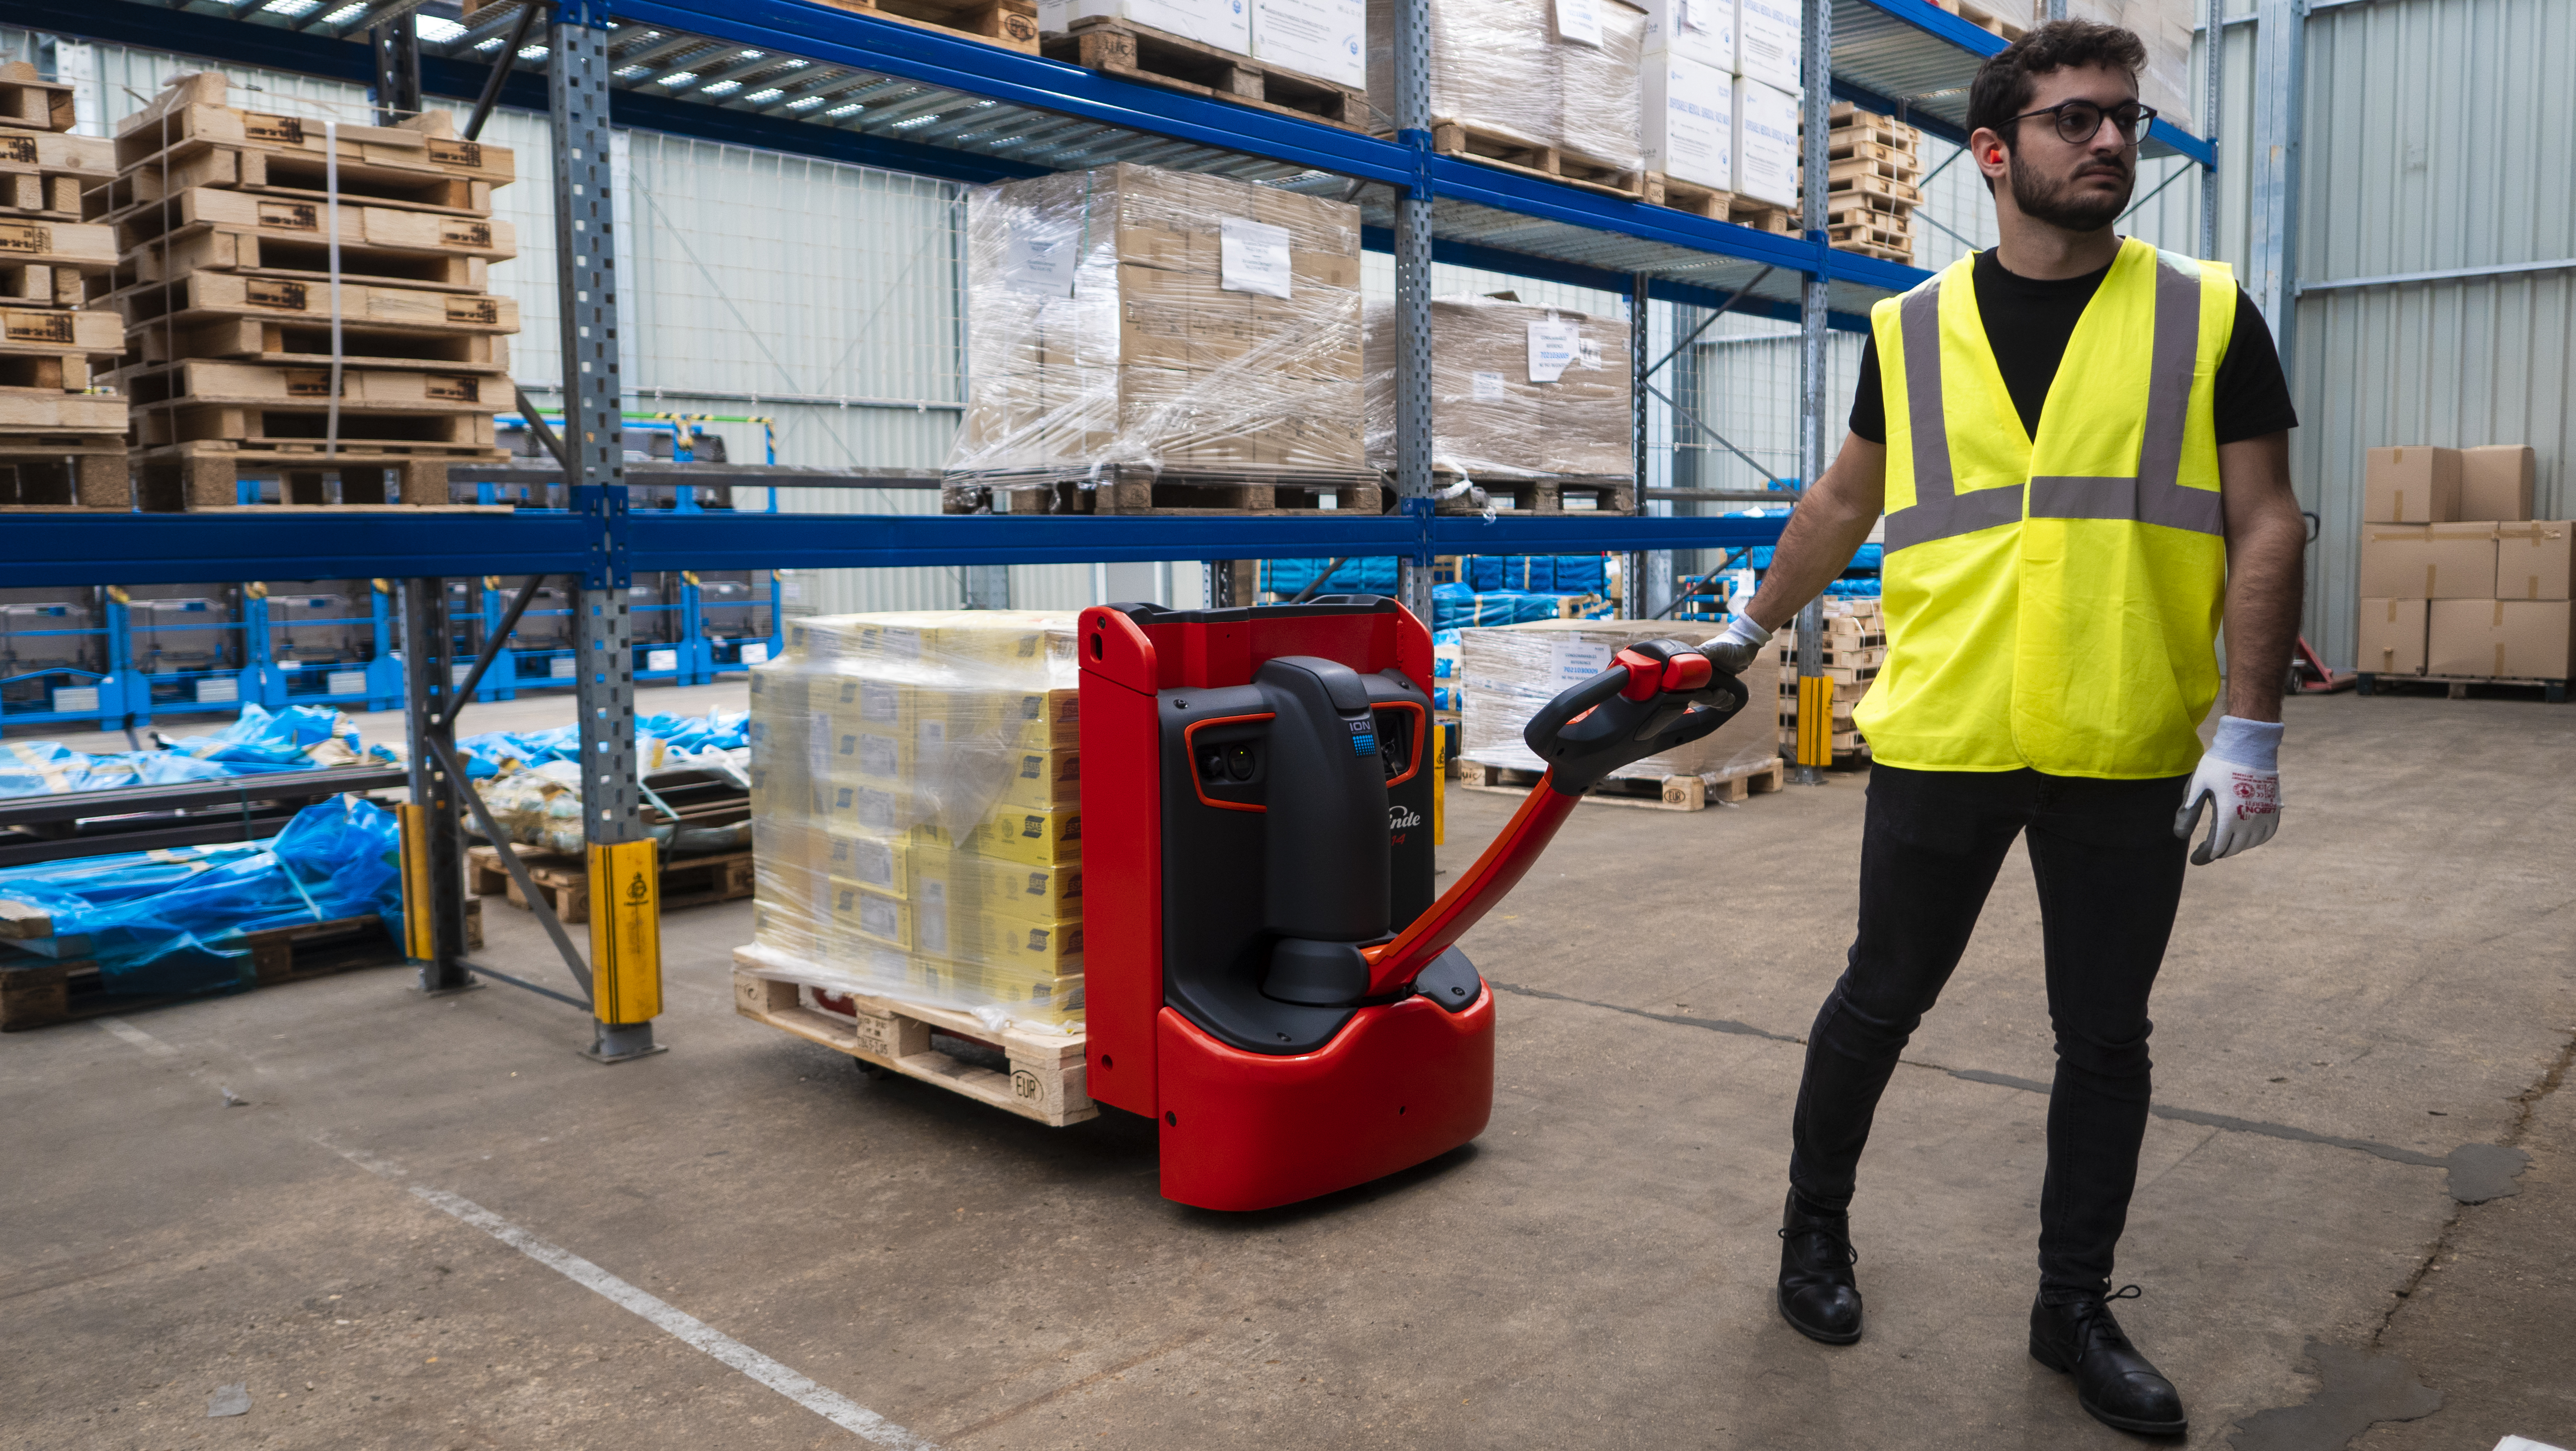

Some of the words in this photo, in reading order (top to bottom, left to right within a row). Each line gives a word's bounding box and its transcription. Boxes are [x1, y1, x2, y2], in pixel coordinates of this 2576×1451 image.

[1563, 666, 1599, 674] 7021030009
[1349, 721, 1370, 731] ION
[1669, 791, 1681, 802] EUR
[2246, 806, 2277, 814] LEBON
[1025, 820, 1043, 832] ESAB
[1029, 877, 1046, 889] ESAB
[1029, 933, 1047, 945] ESAB
[1016, 1075, 1036, 1100] EUR
